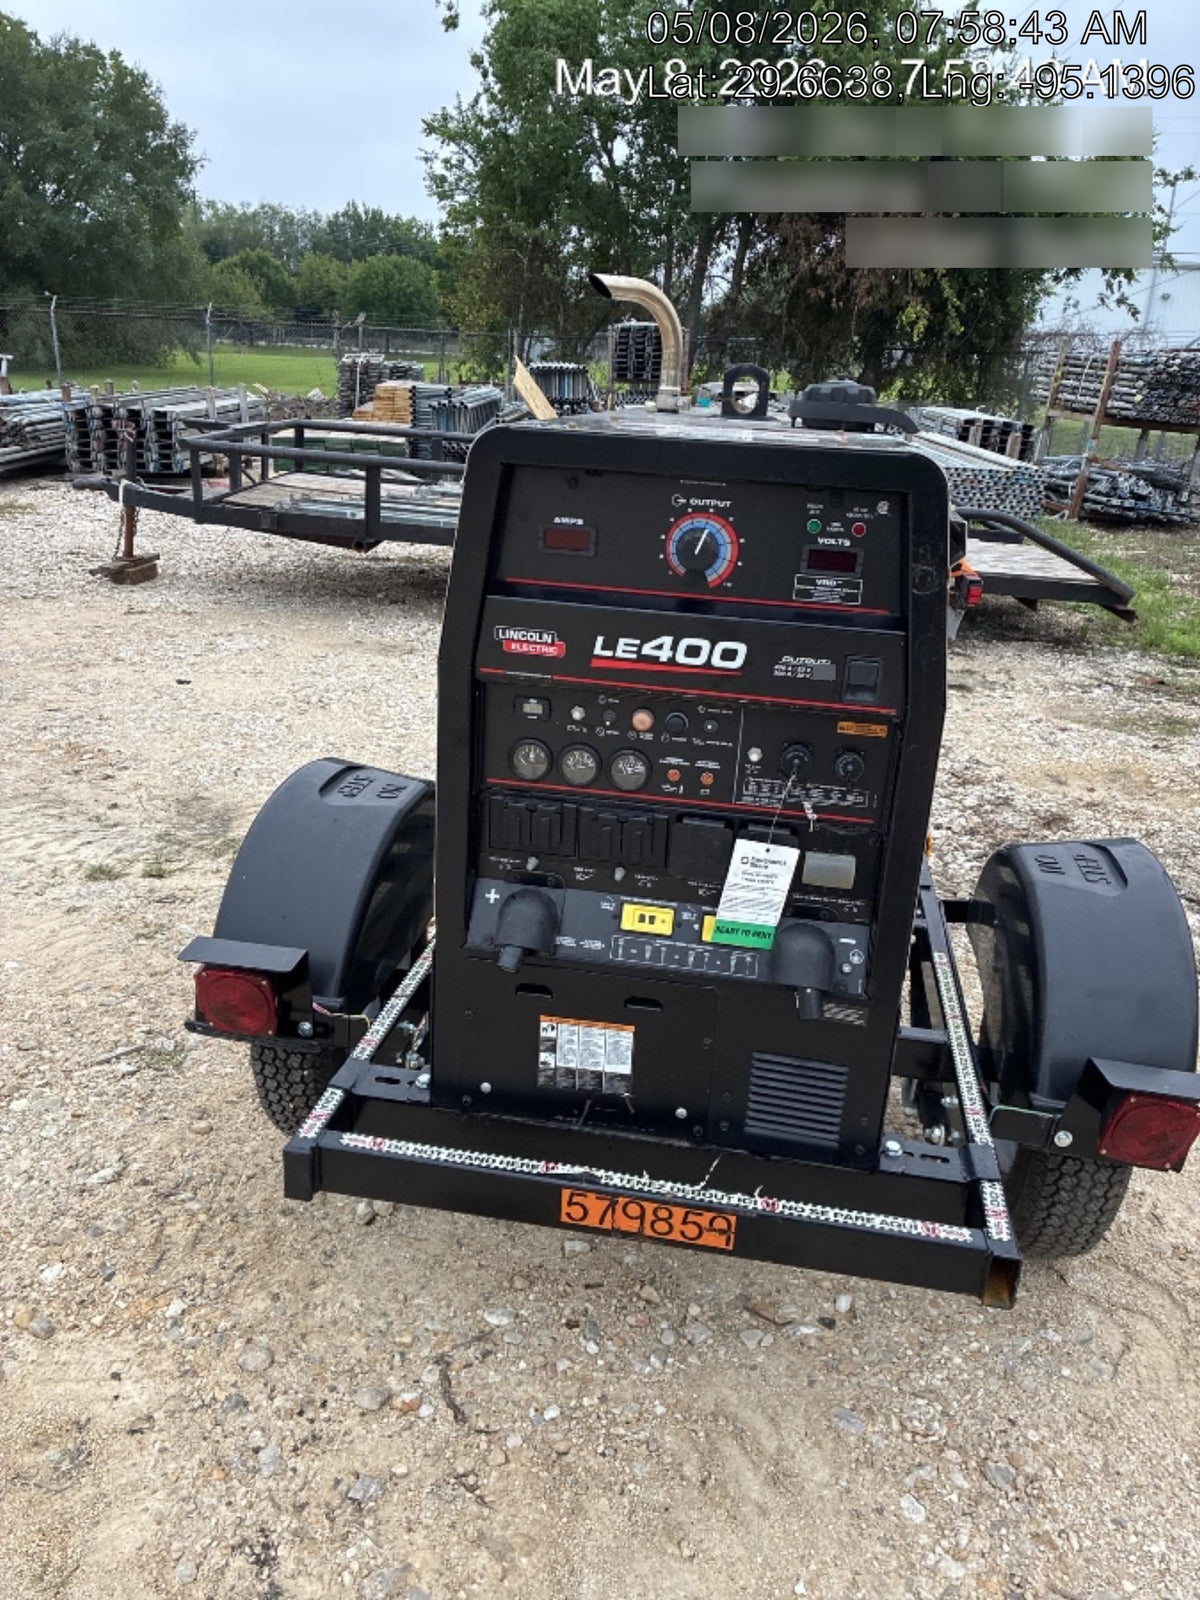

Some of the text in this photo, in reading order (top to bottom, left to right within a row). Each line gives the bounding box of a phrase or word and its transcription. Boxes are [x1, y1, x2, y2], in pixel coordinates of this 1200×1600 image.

[690, 498, 732, 507] OUTPUT
[553, 516, 584, 525] AMPS
[817, 537, 851, 546] VOLTS
[499, 628, 553, 643] LINCOLN
[511, 643, 558, 655] ELECTRIC
[593, 635, 748, 669] LE400
[741, 928, 751, 937] TO
[752, 930, 772, 940] RENT
[564, 1189, 735, 1248] 579859
[832, 1210, 876, 1225] PARE
